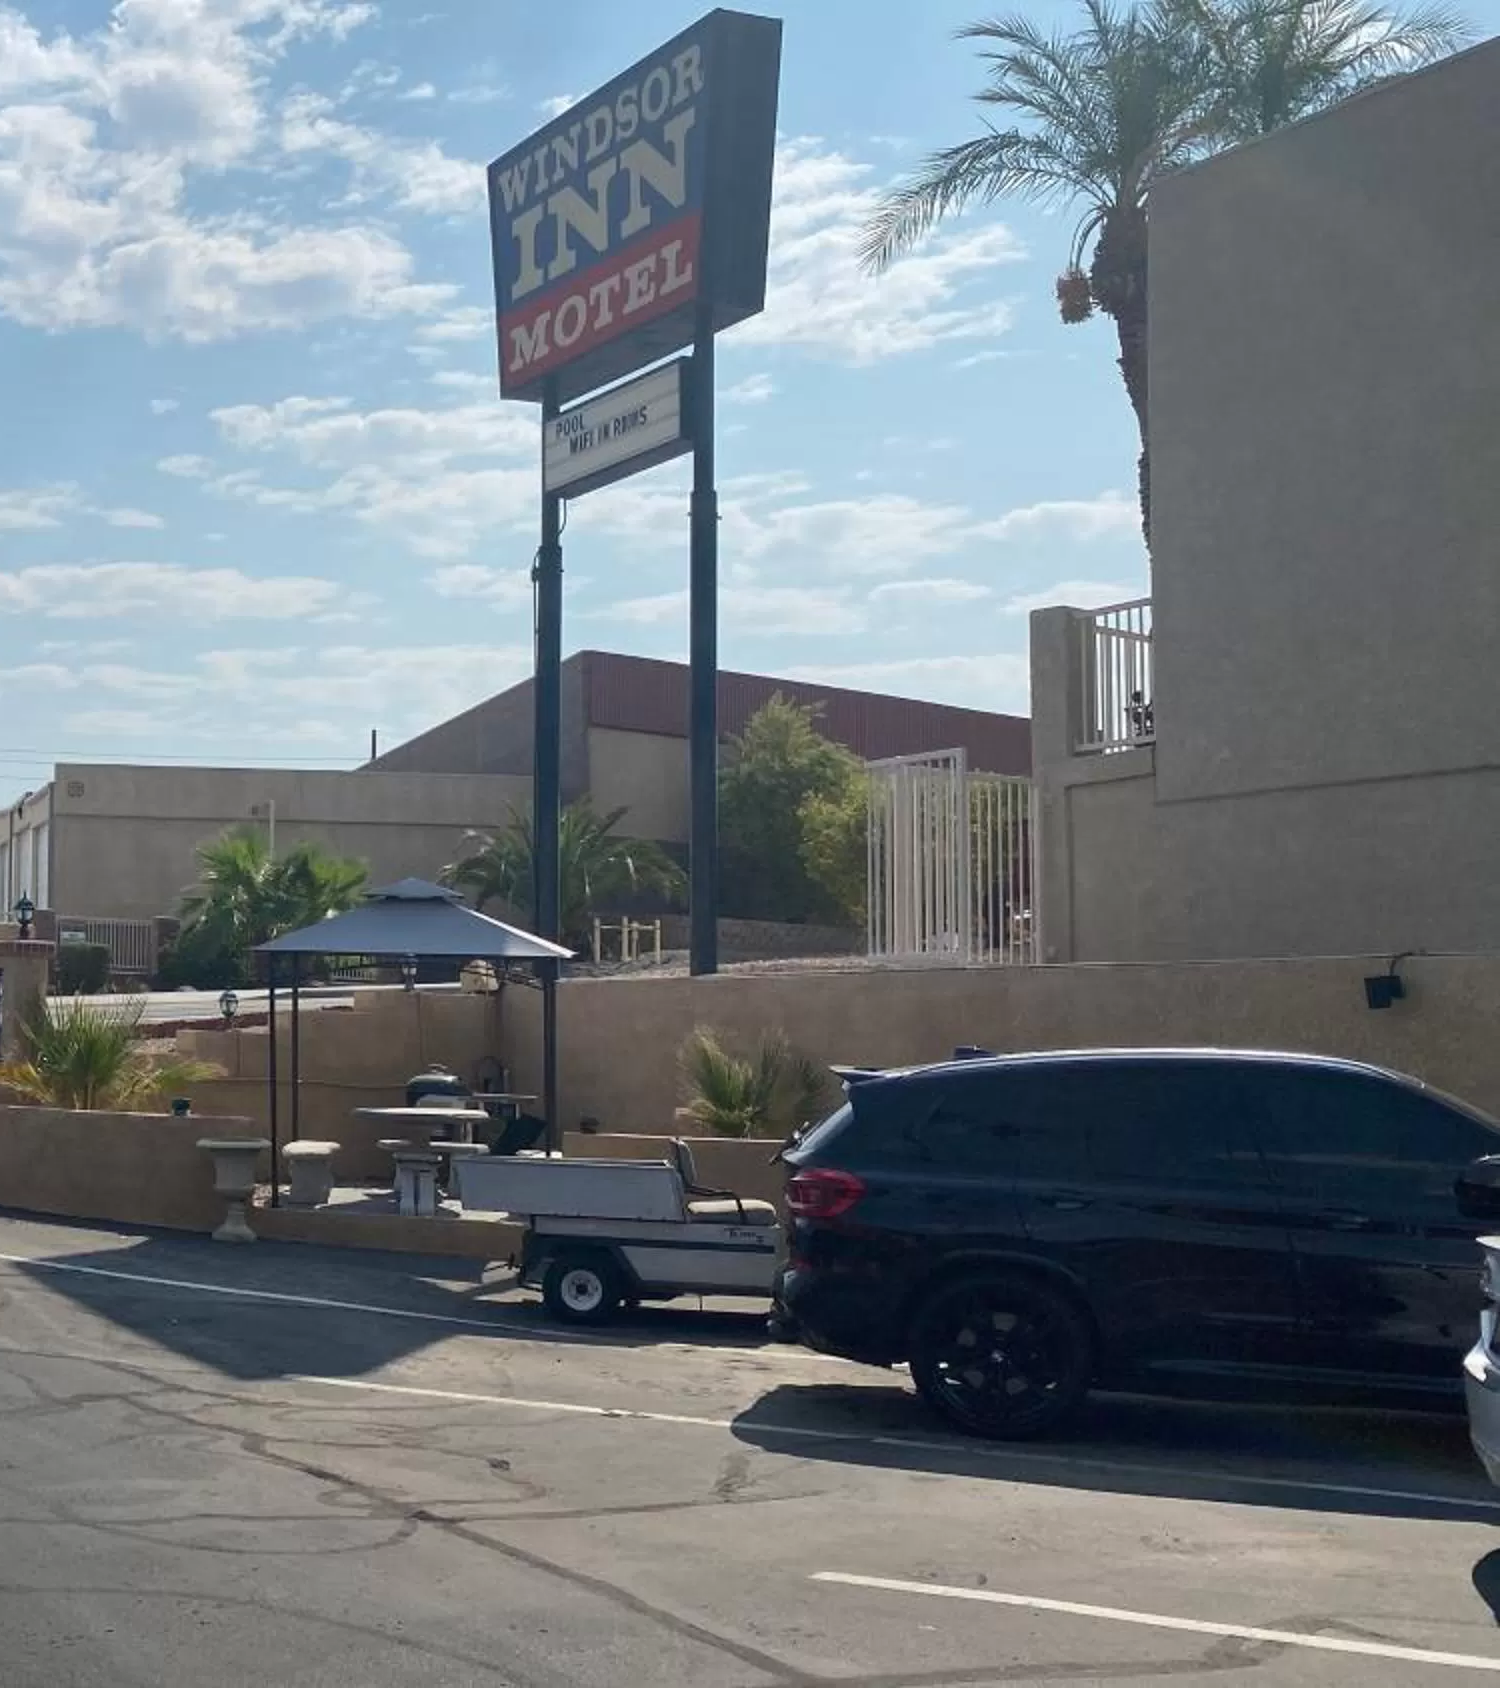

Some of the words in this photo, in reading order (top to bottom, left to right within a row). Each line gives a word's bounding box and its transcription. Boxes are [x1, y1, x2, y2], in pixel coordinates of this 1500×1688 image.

[499, 44, 705, 213] WINDSOR
[511, 107, 696, 300] INN
[509, 239, 694, 373] MOTEL
[556, 413, 585, 438] POOL
